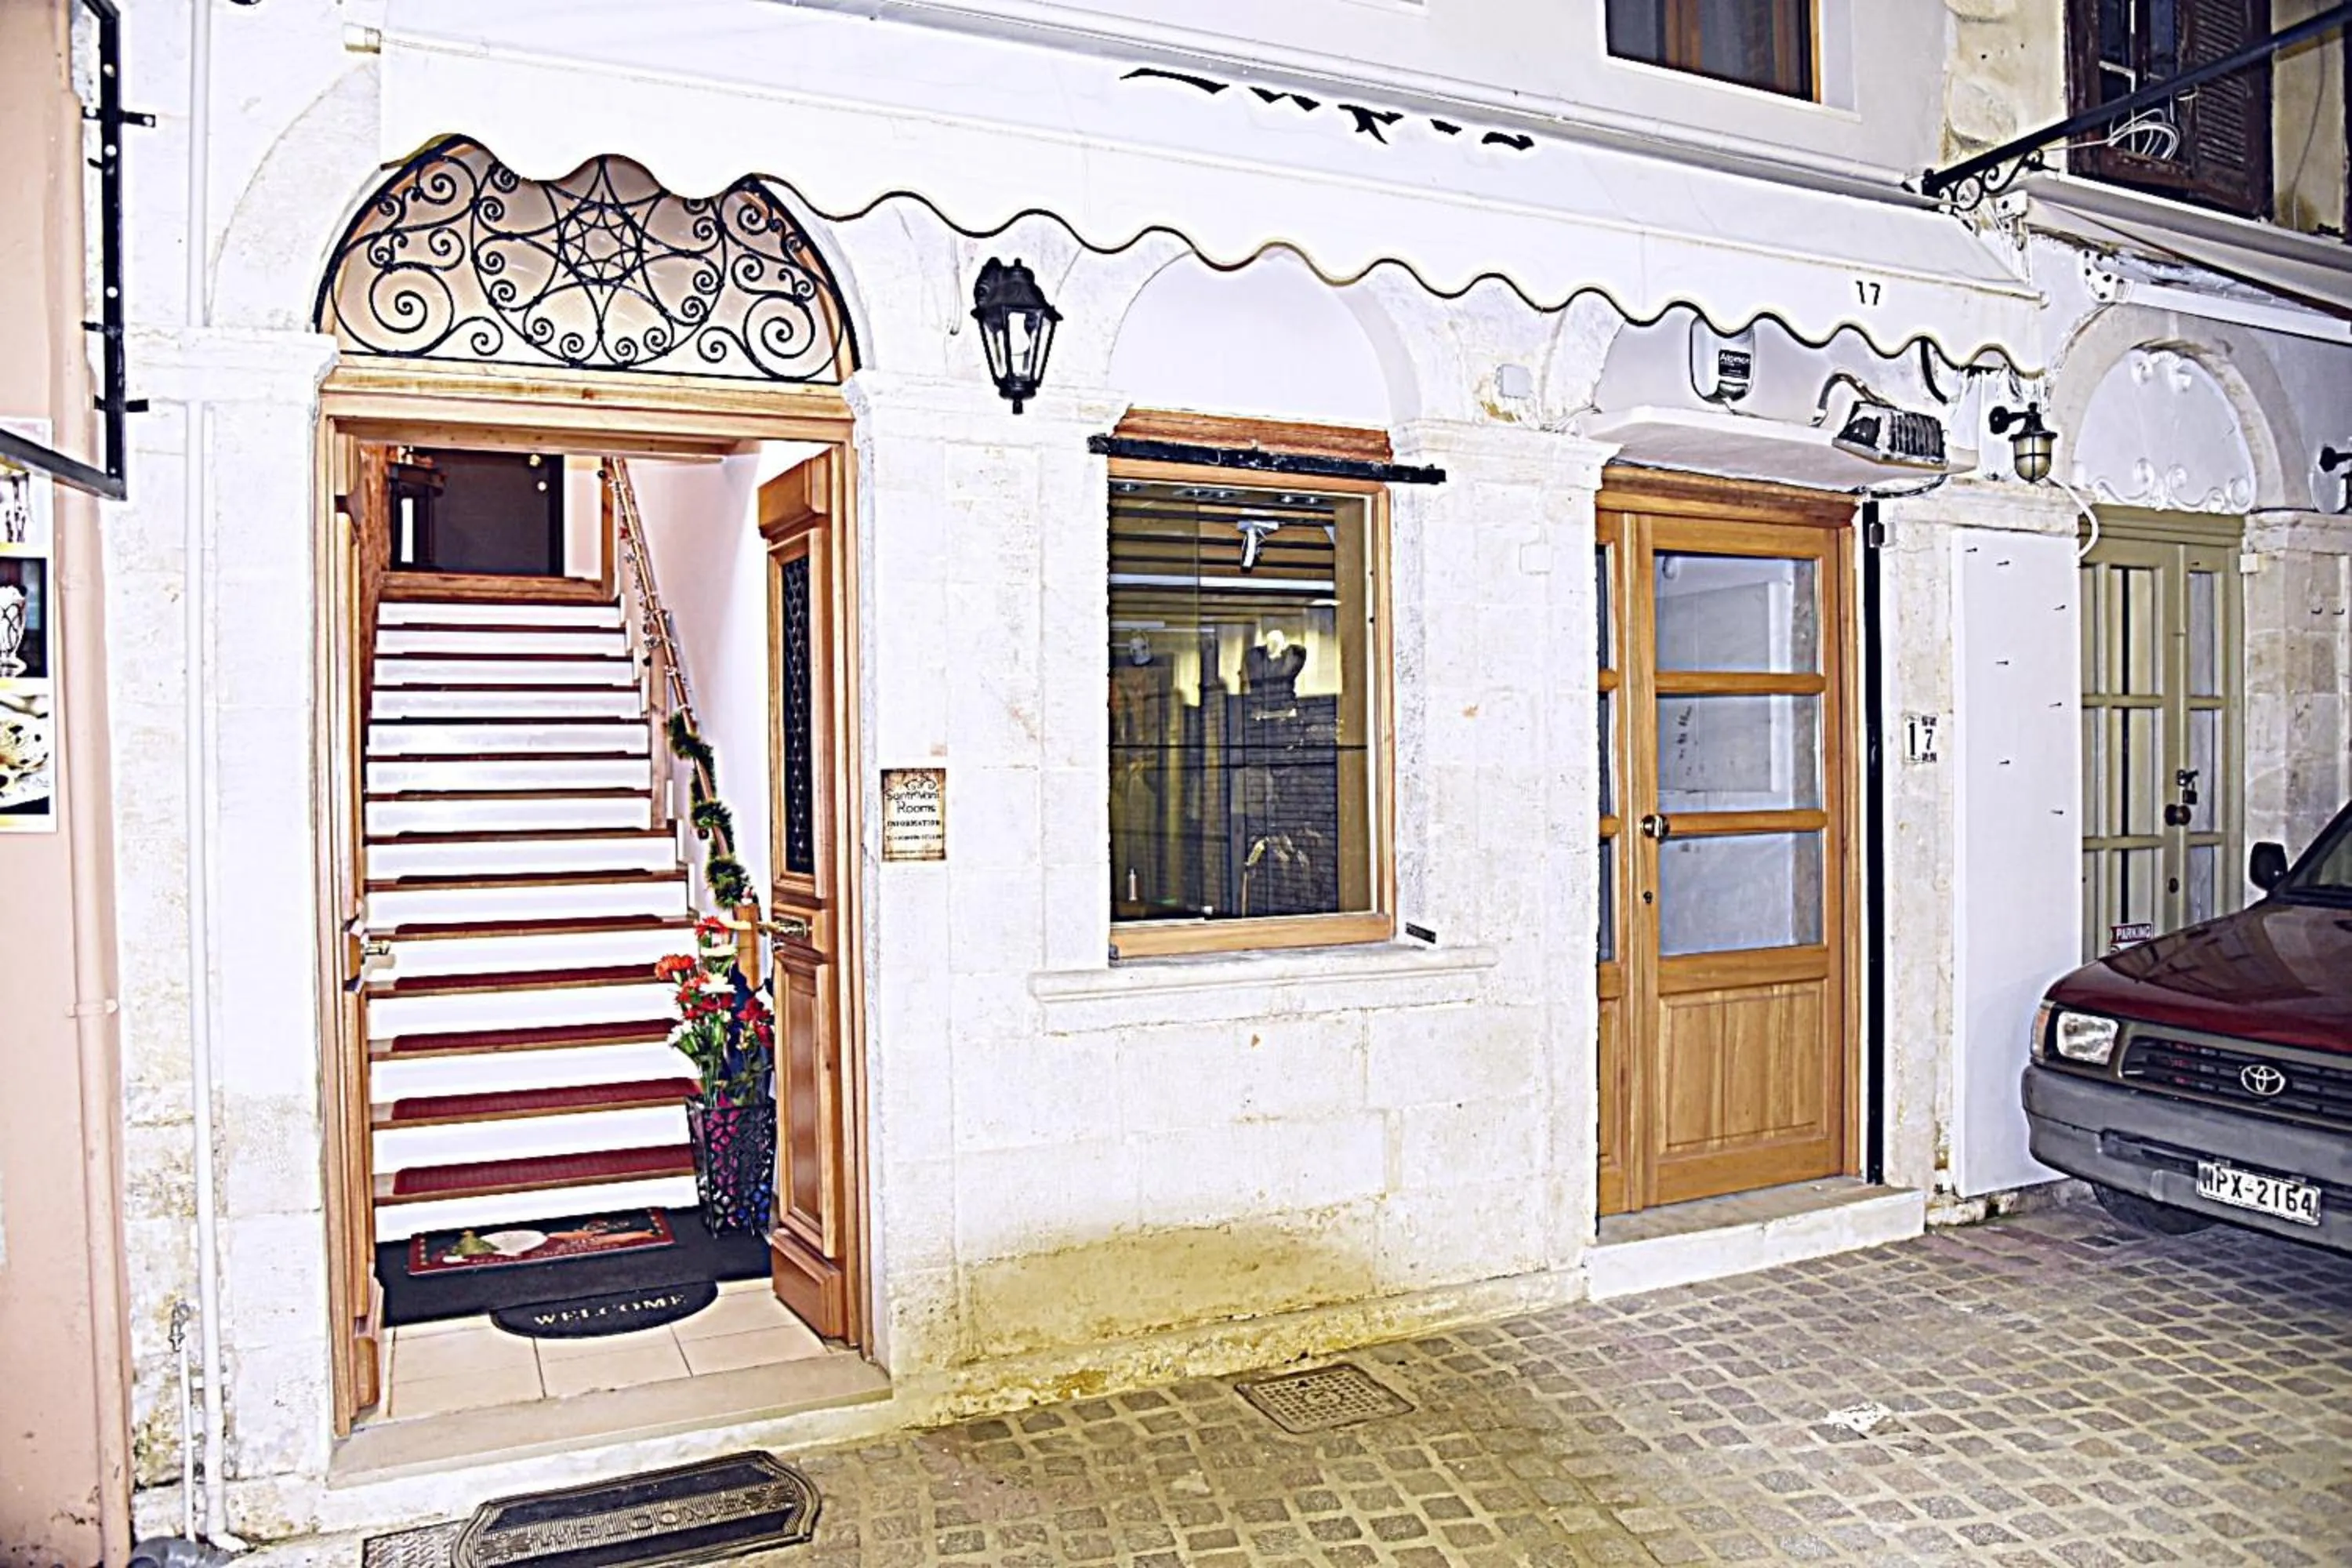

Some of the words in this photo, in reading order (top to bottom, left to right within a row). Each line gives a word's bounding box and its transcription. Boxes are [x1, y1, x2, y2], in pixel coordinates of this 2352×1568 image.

[1856, 280, 1880, 306] 17
[1908, 722, 1933, 757] 17
[897, 800, 936, 813] Rooms
[2117, 926, 2151, 941] PARKING
[534, 1294, 686, 1325] WELCOME
[533, 1498, 747, 1546] WELCOME
